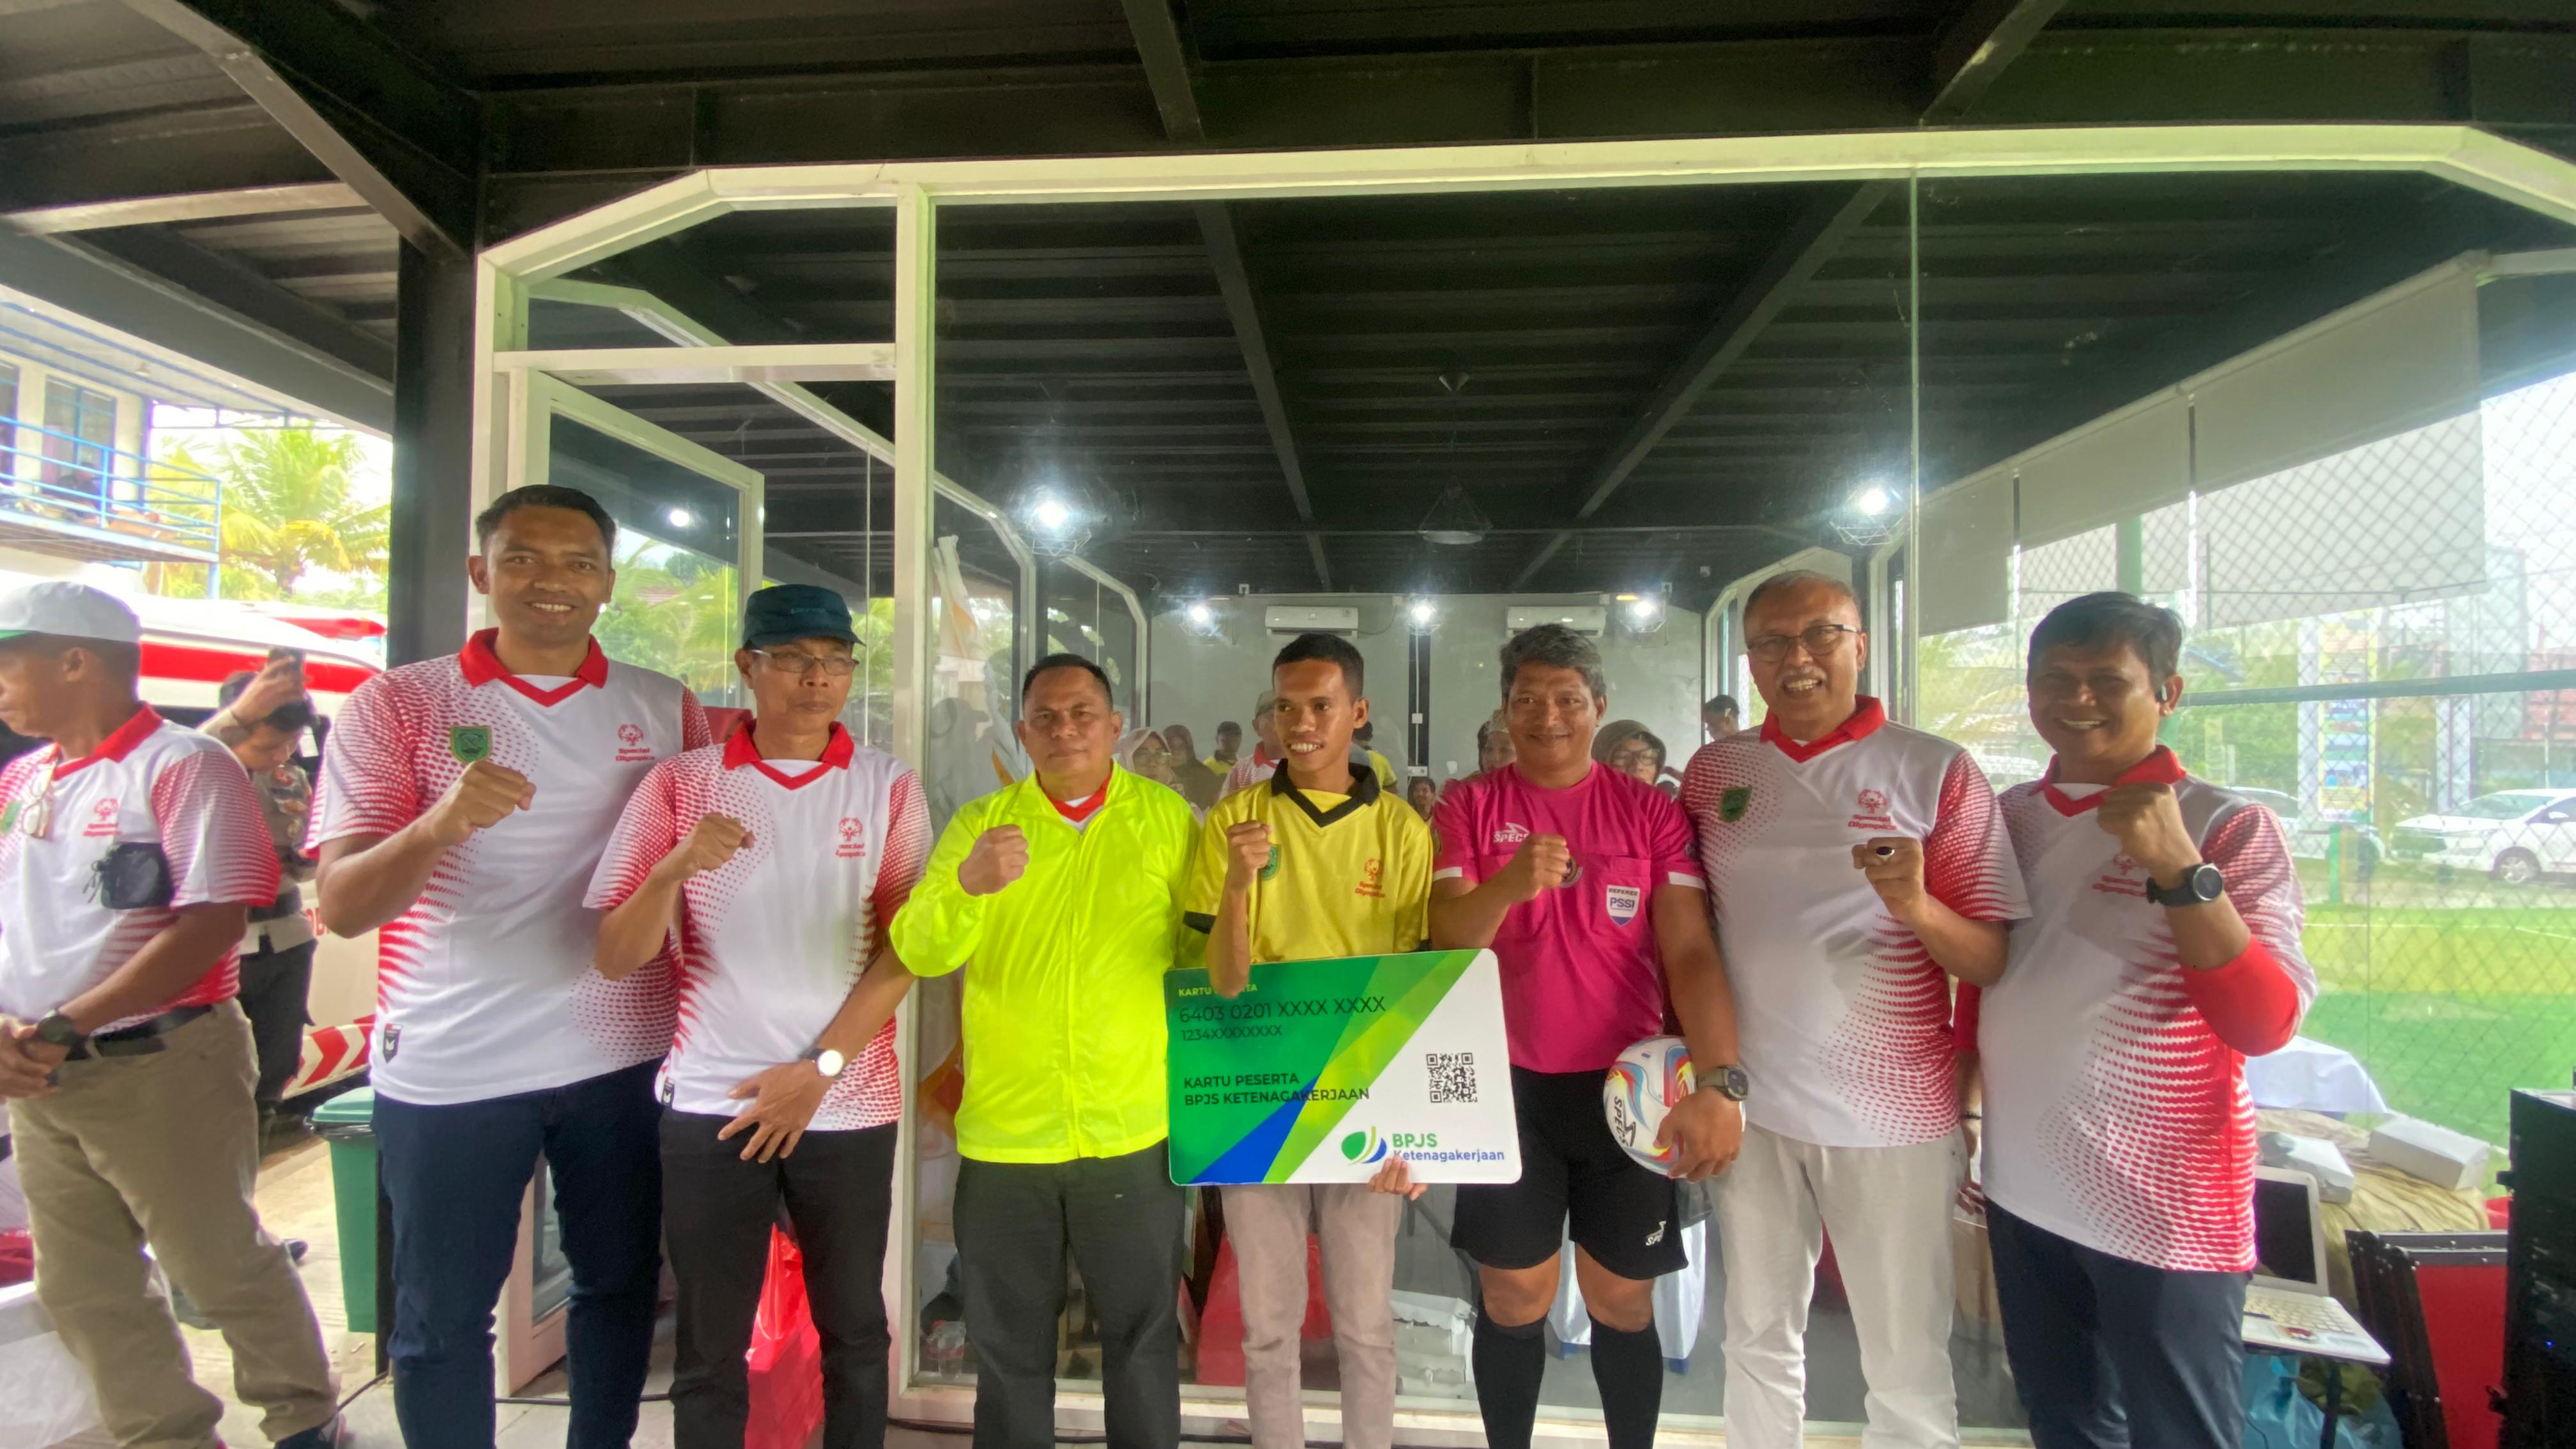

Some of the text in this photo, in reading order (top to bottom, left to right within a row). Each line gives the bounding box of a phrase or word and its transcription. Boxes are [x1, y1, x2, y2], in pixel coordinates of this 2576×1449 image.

[1610, 897, 1636, 908] PSSI
[1178, 986, 1212, 997] KARTU
[1179, 996, 1386, 1023] 6403 0201 XXXX XXXX
[1181, 1024, 1284, 1042] 1234XXXXXXXX
[1184, 1073, 1300, 1089] KARTU PESERTA
[1184, 1087, 1370, 1106] BPJS KETENAGAKERJAAN
[1614, 1096, 1629, 1146] SPECS
[1392, 1133, 1438, 1148] BPJS
